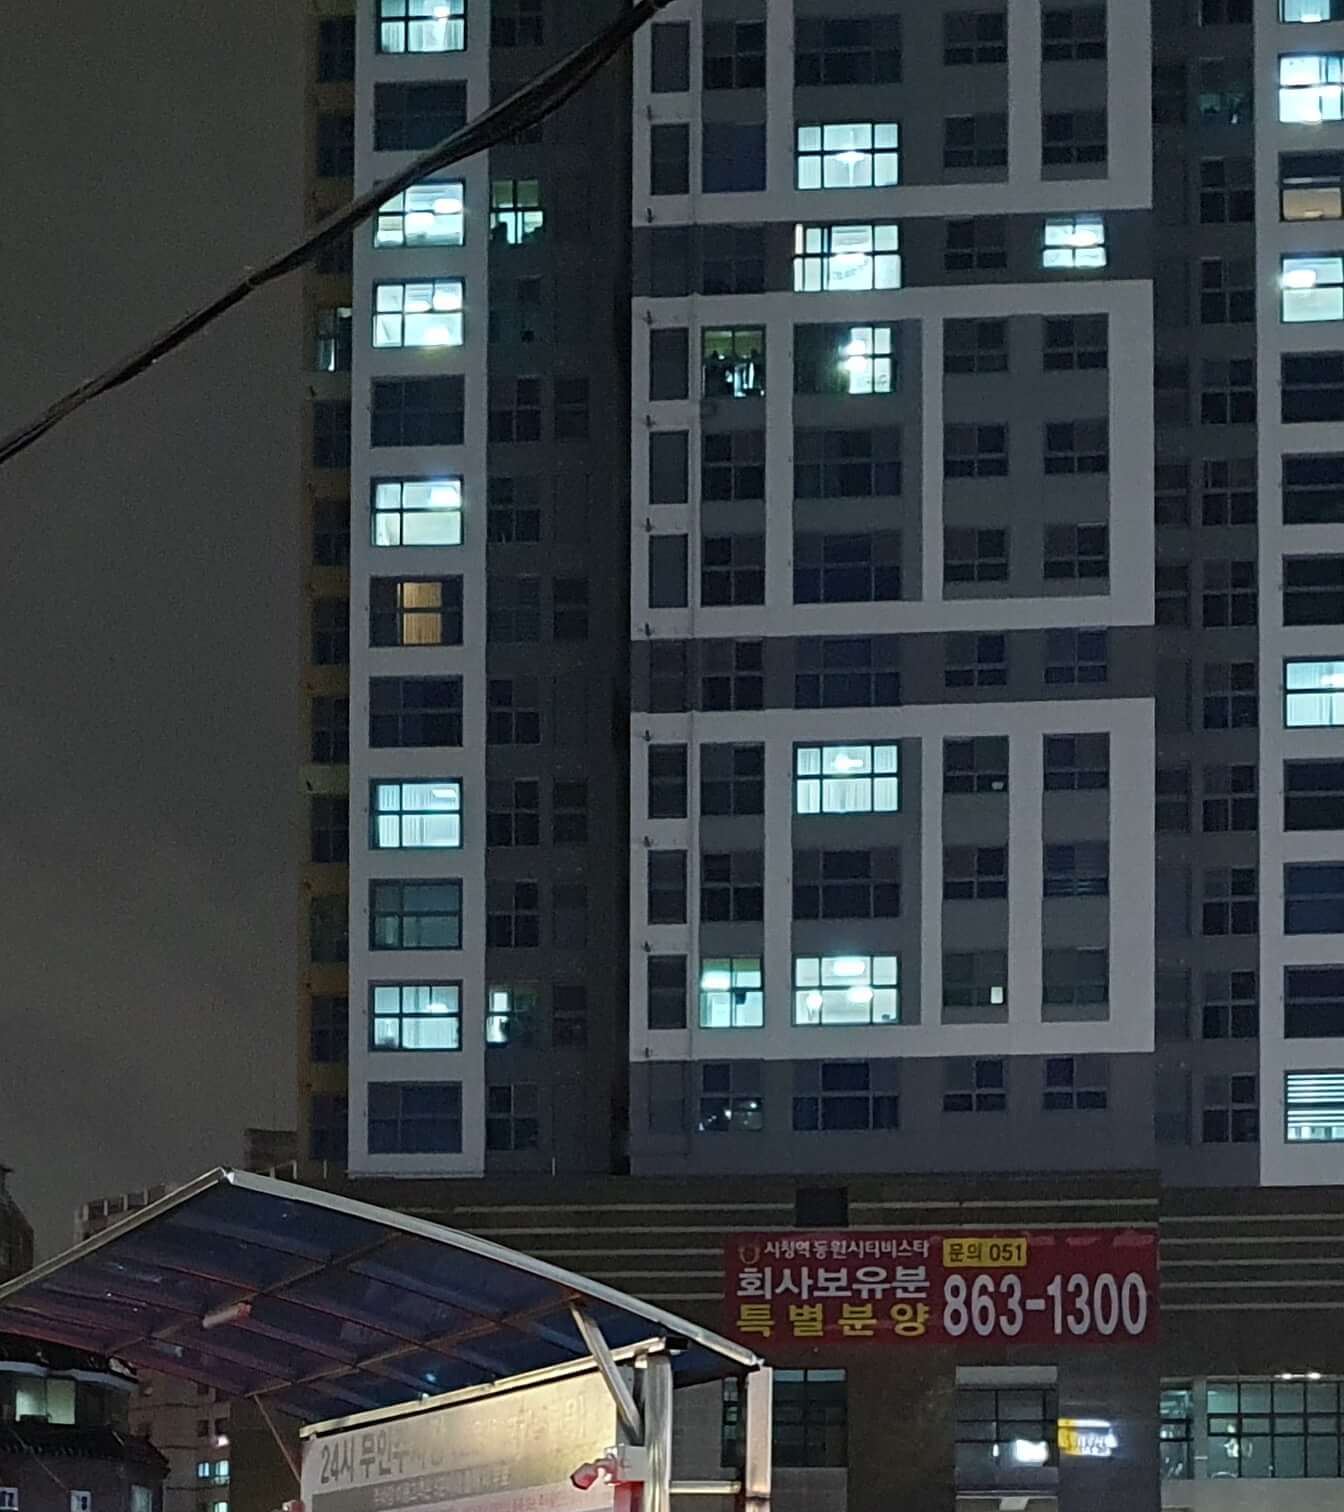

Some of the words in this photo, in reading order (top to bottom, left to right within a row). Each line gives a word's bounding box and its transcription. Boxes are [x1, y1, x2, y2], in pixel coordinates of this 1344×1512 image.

[948, 1241, 982, 1263] 문의
[988, 1241, 1024, 1262] 051
[736, 1266, 931, 1300] 회사보유분
[736, 1302, 930, 1337] 특별분양
[943, 1272, 1148, 1337] 863-1300
